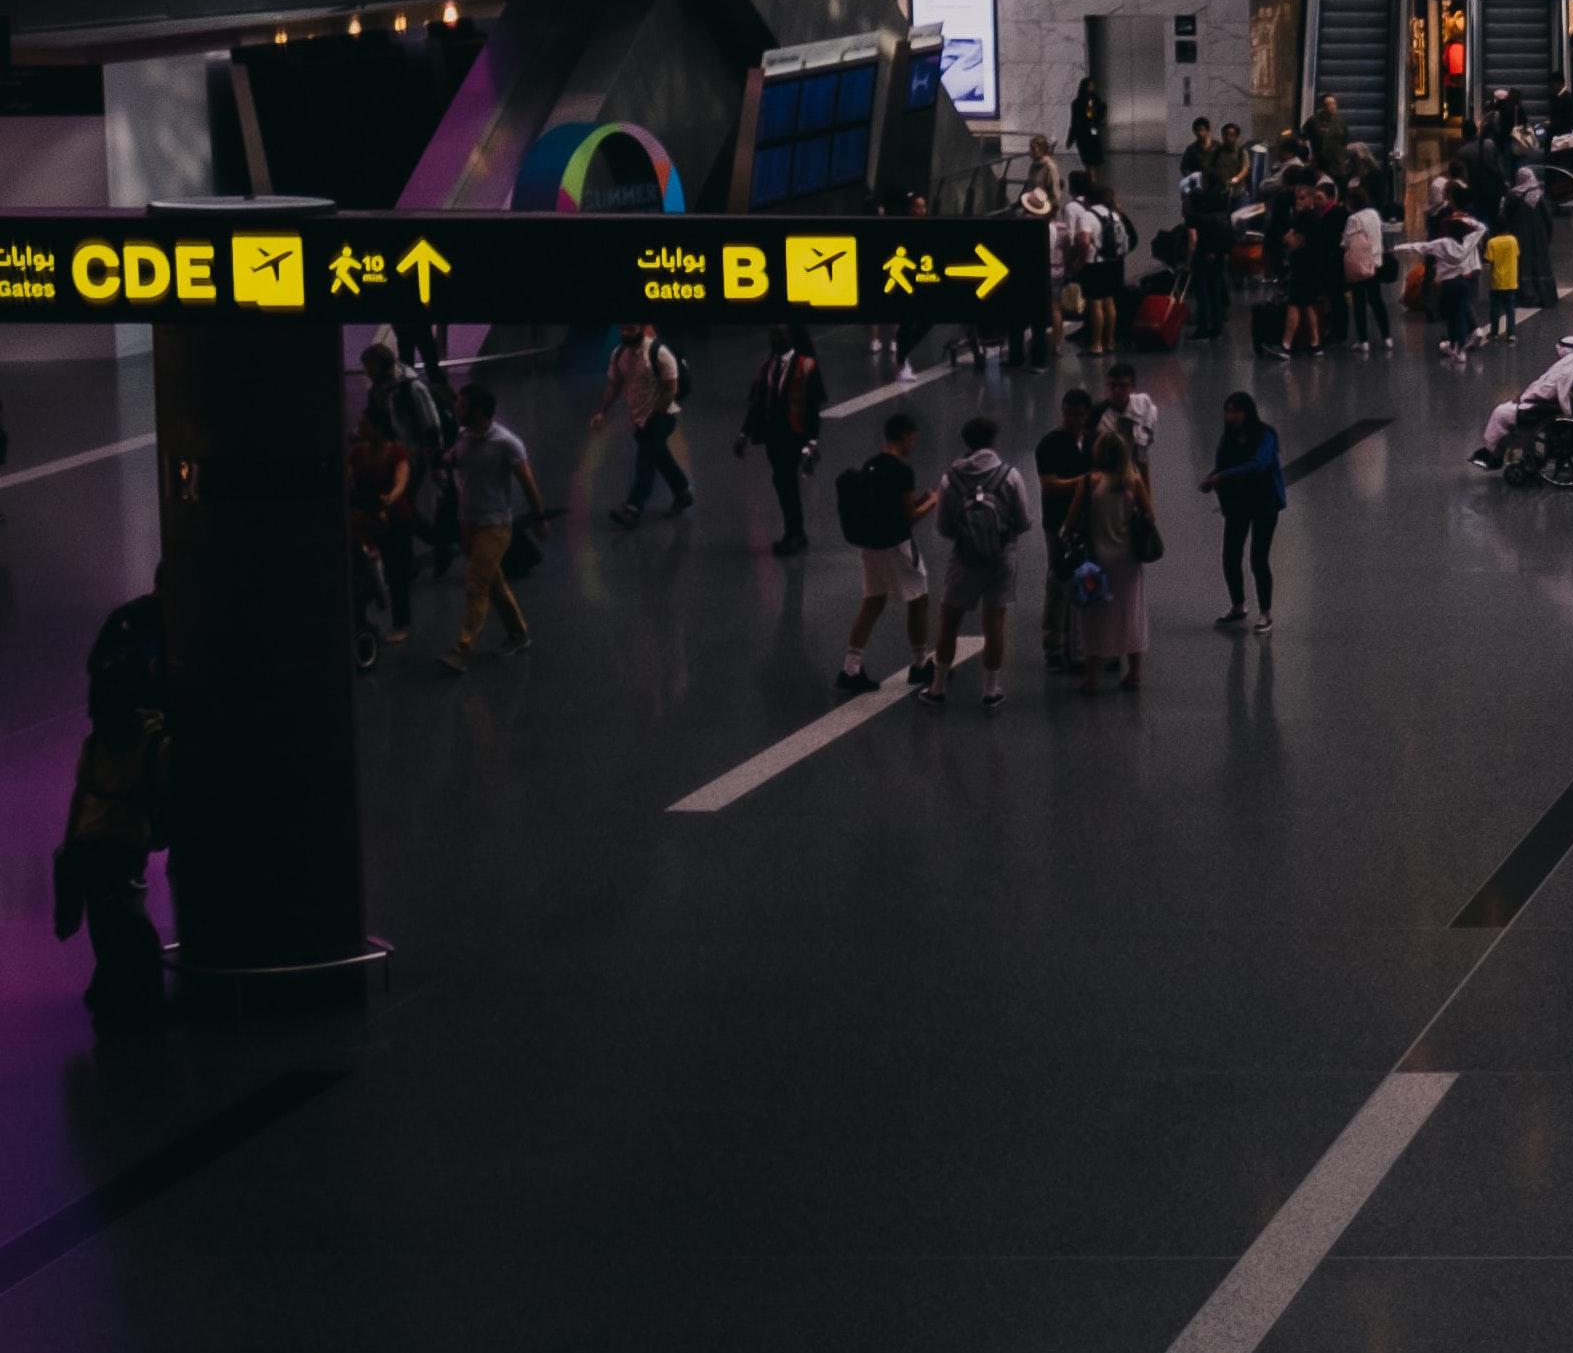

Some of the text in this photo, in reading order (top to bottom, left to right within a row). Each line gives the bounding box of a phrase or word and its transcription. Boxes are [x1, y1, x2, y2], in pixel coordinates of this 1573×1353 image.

[71, 243, 217, 300] CDE
[362, 254, 385, 272] 10
[637, 246, 707, 274] بوابات
[920, 254, 933, 272] 3
[723, 246, 770, 300] B
[644, 281, 707, 300] Gates
